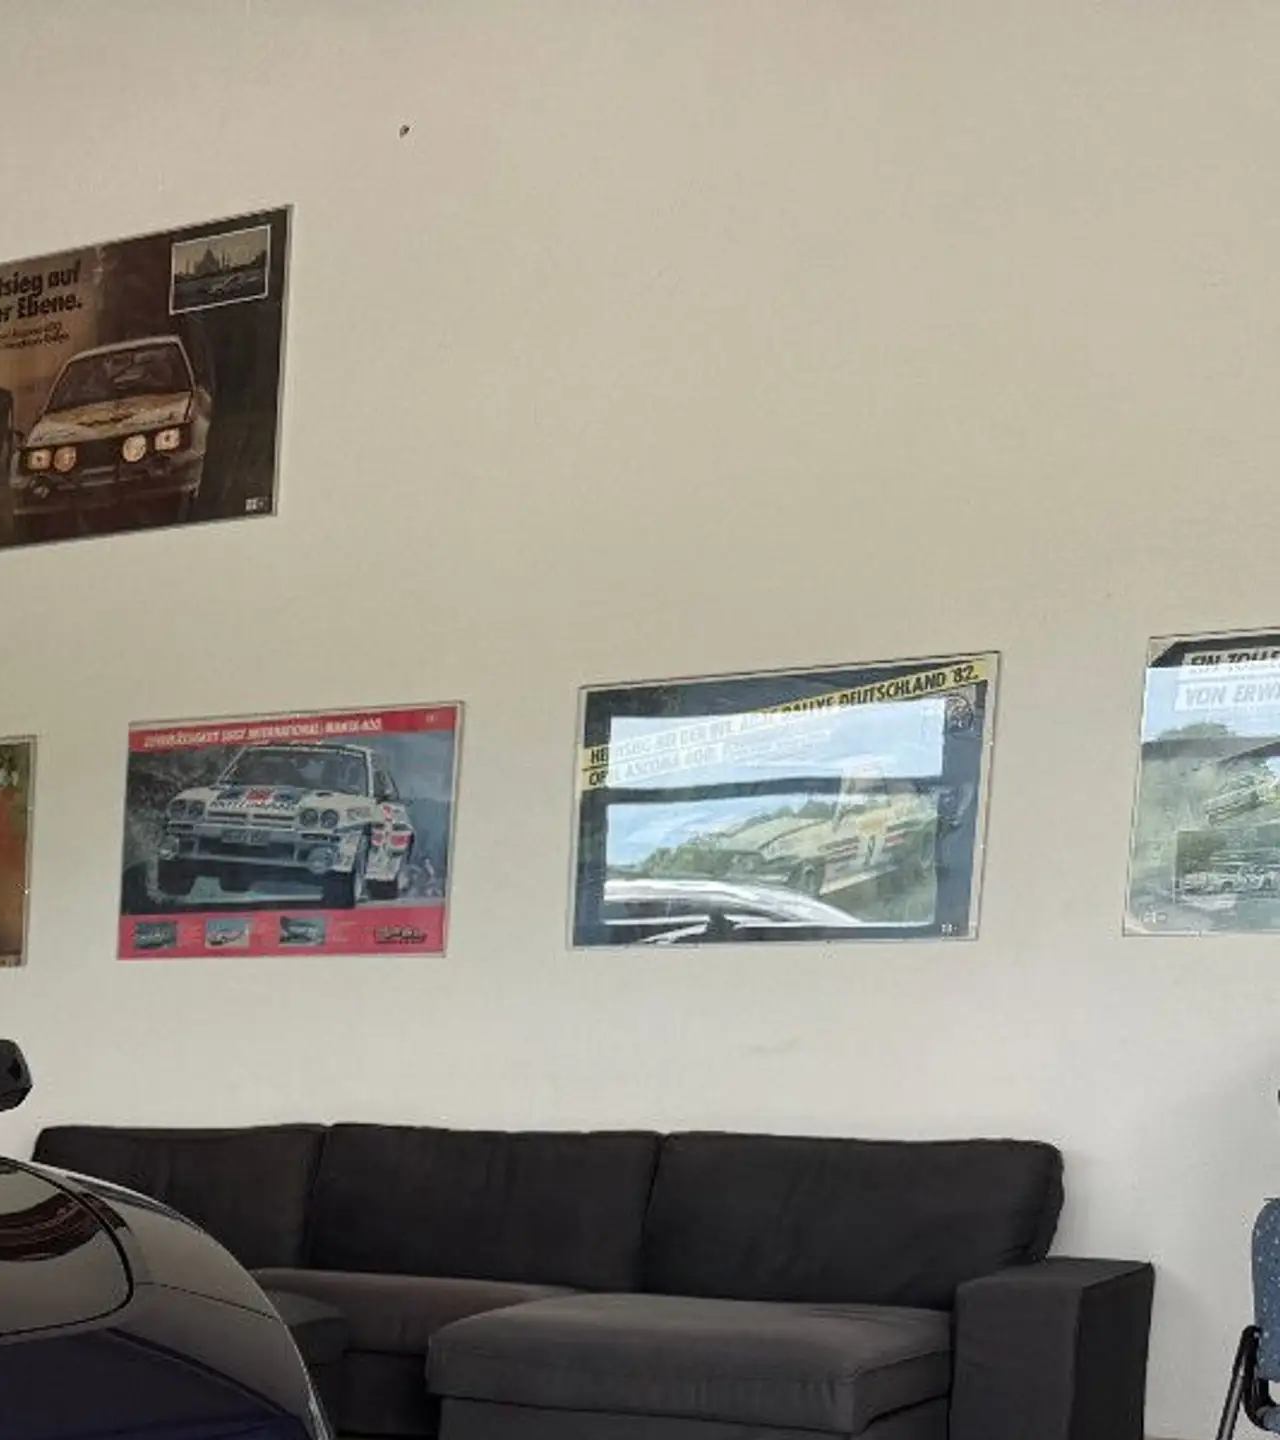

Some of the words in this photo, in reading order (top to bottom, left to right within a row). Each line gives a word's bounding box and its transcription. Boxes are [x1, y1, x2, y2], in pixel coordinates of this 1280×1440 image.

[47, 258, 81, 289] auf
[16, 293, 83, 319] Ebene.
[840, 671, 947, 706] DEUTSCHLAND
